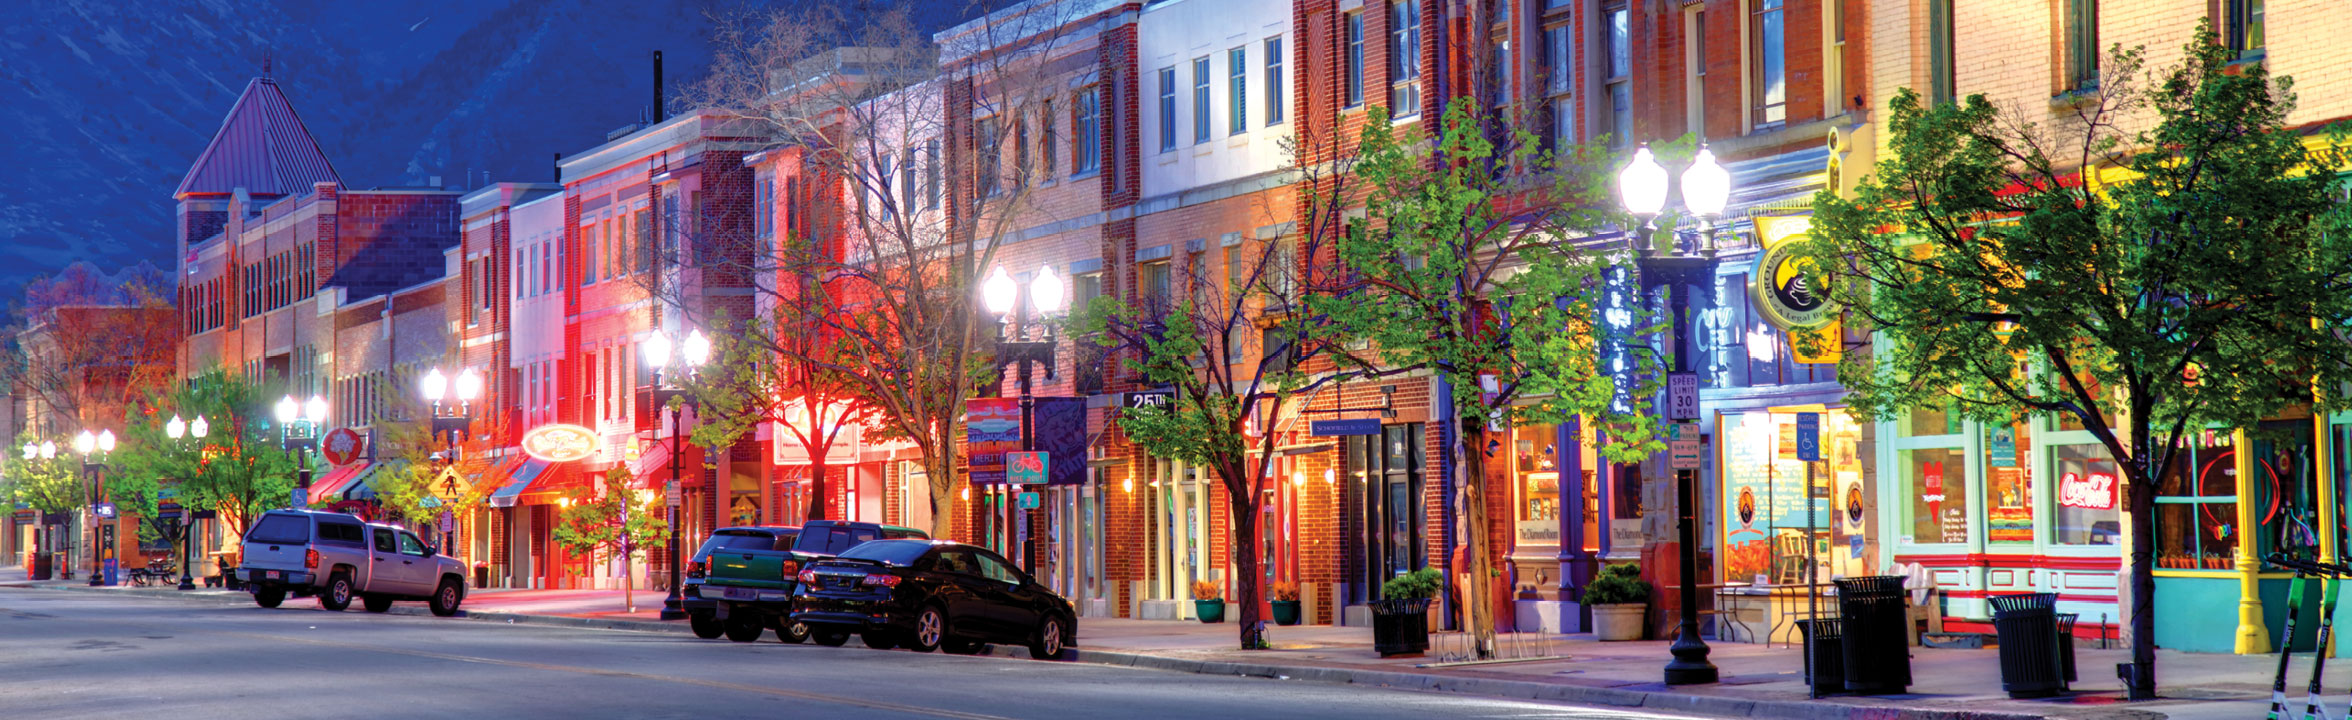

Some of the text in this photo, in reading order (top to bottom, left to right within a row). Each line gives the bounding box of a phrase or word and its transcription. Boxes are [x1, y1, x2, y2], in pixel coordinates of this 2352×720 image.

[1786, 312, 1811, 322] Legal
[1672, 378, 1696, 386] SPEED
[1674, 387, 1695, 395] LIMIT
[1677, 396, 1693, 408] 30
[1676, 408, 1695, 416] MPH
[1672, 427, 1679, 438] 2
[1527, 528, 1545, 540] Diamond
[1545, 528, 1558, 540] Room
